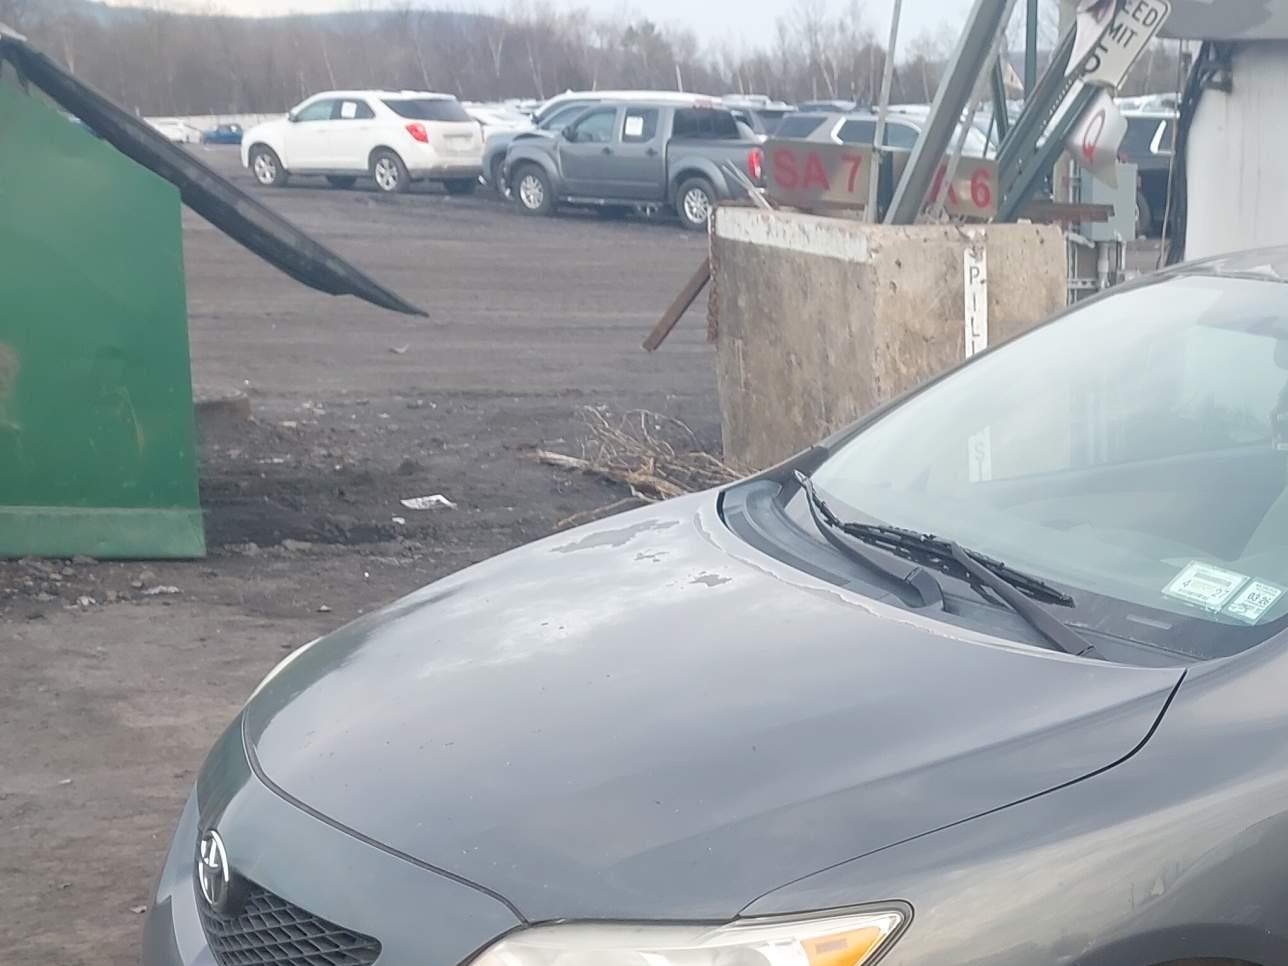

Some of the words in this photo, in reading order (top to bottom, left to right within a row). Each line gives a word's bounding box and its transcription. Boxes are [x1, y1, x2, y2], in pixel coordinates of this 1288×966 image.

[772, 146, 830, 192] SA
[841, 154, 863, 193] 7
[970, 167, 992, 209] 6
